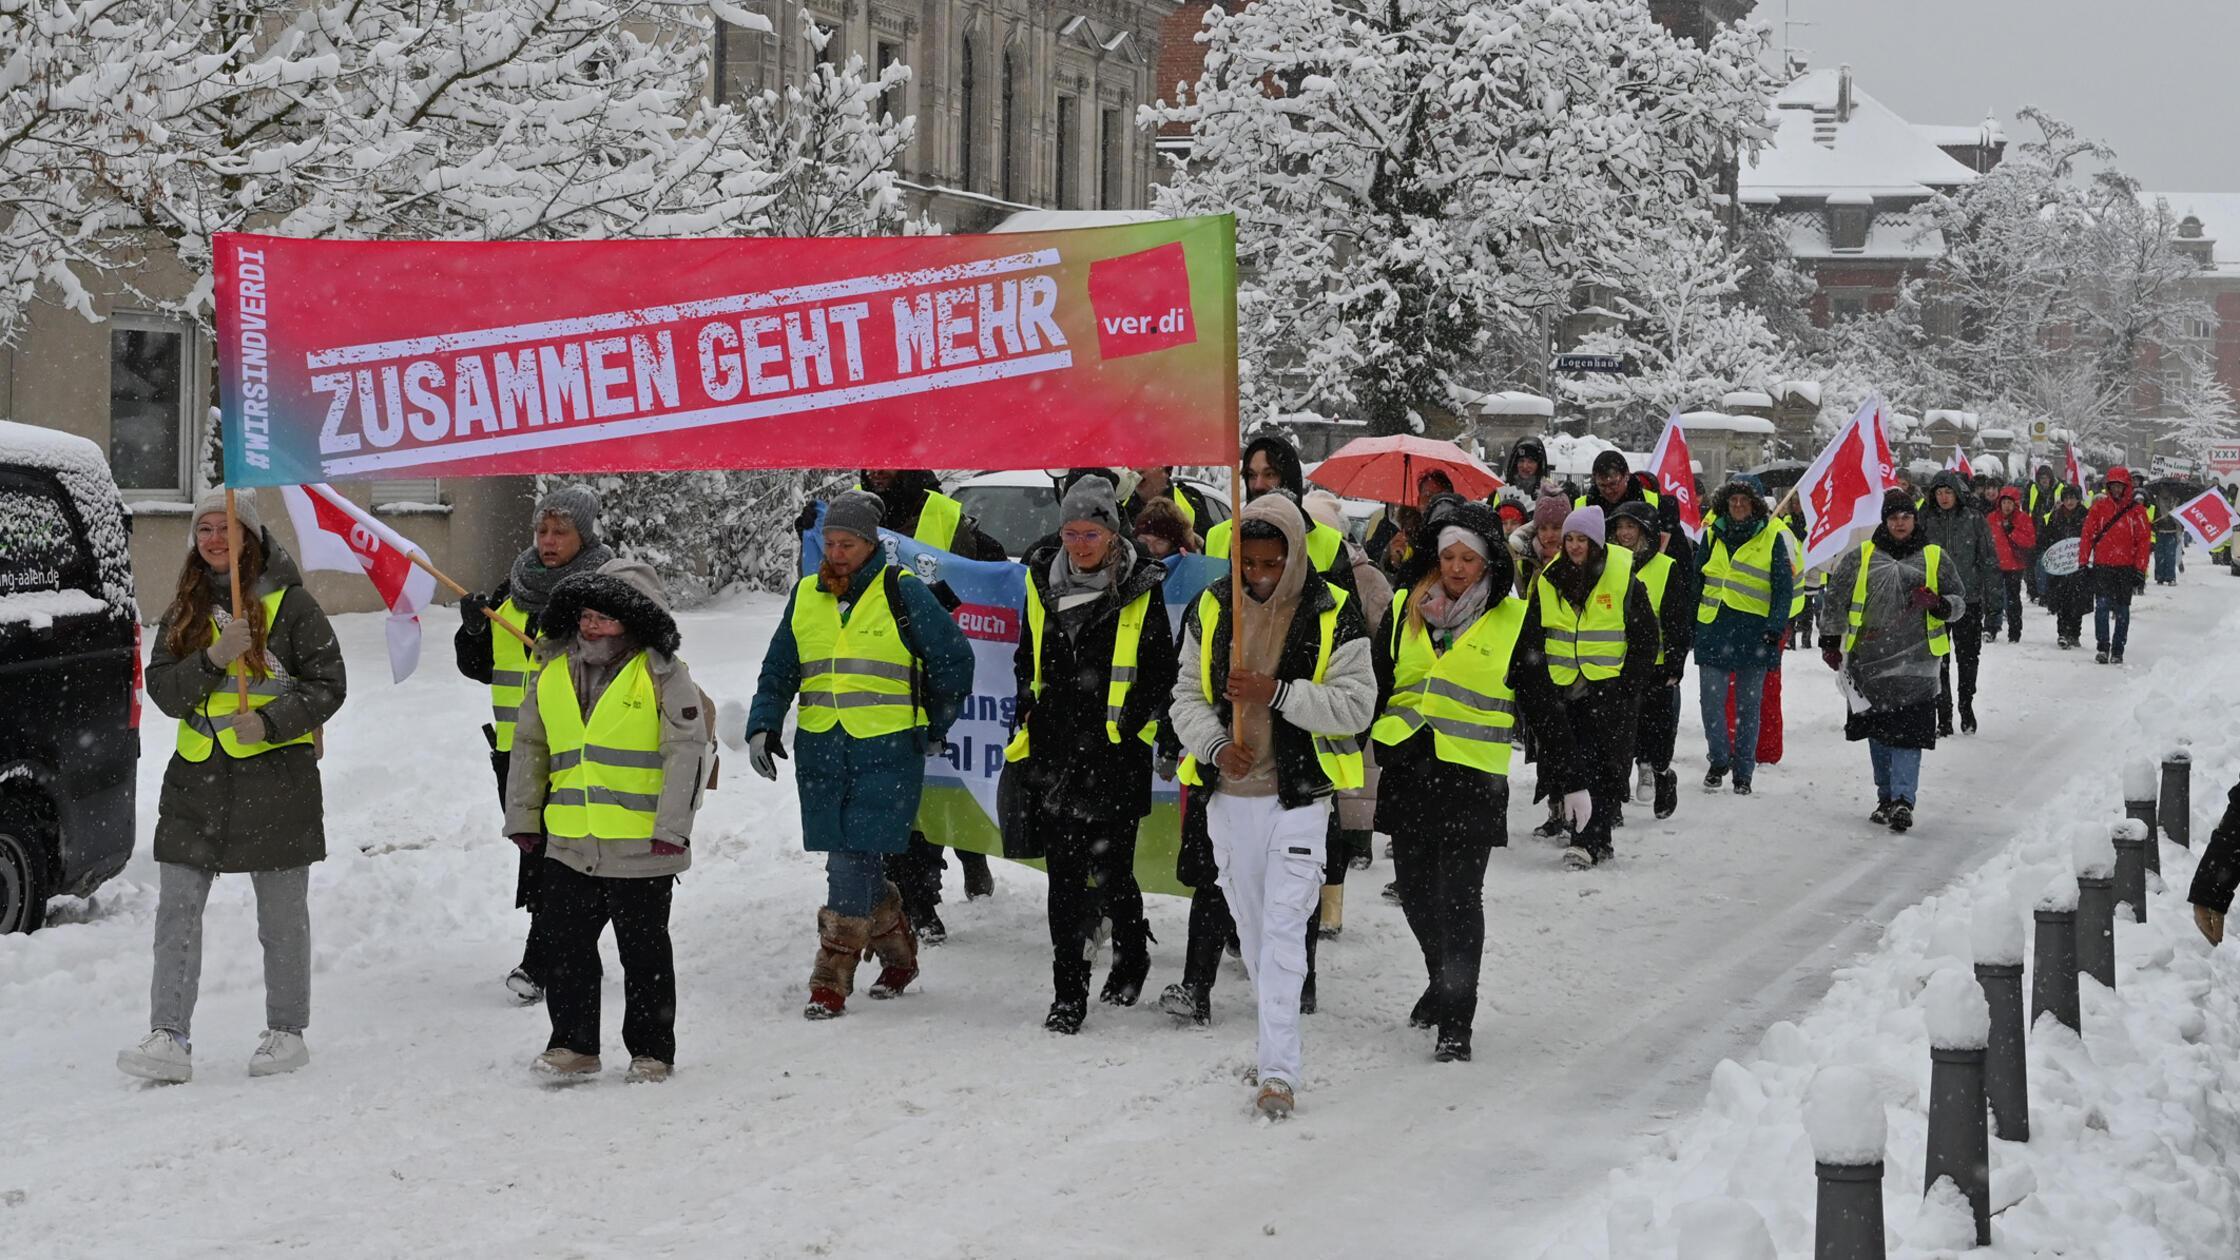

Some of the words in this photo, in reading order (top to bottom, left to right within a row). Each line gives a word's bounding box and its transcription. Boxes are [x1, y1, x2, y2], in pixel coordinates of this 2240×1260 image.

[237, 246, 271, 471] #WIRSINDVERDI
[310, 329, 681, 455] ZUSAMMEN
[697, 302, 870, 401] GEHT
[892, 274, 1069, 374] MEHR
[1103, 308, 1185, 335] ver.di
[1560, 357, 1620, 369] Logenhaus
